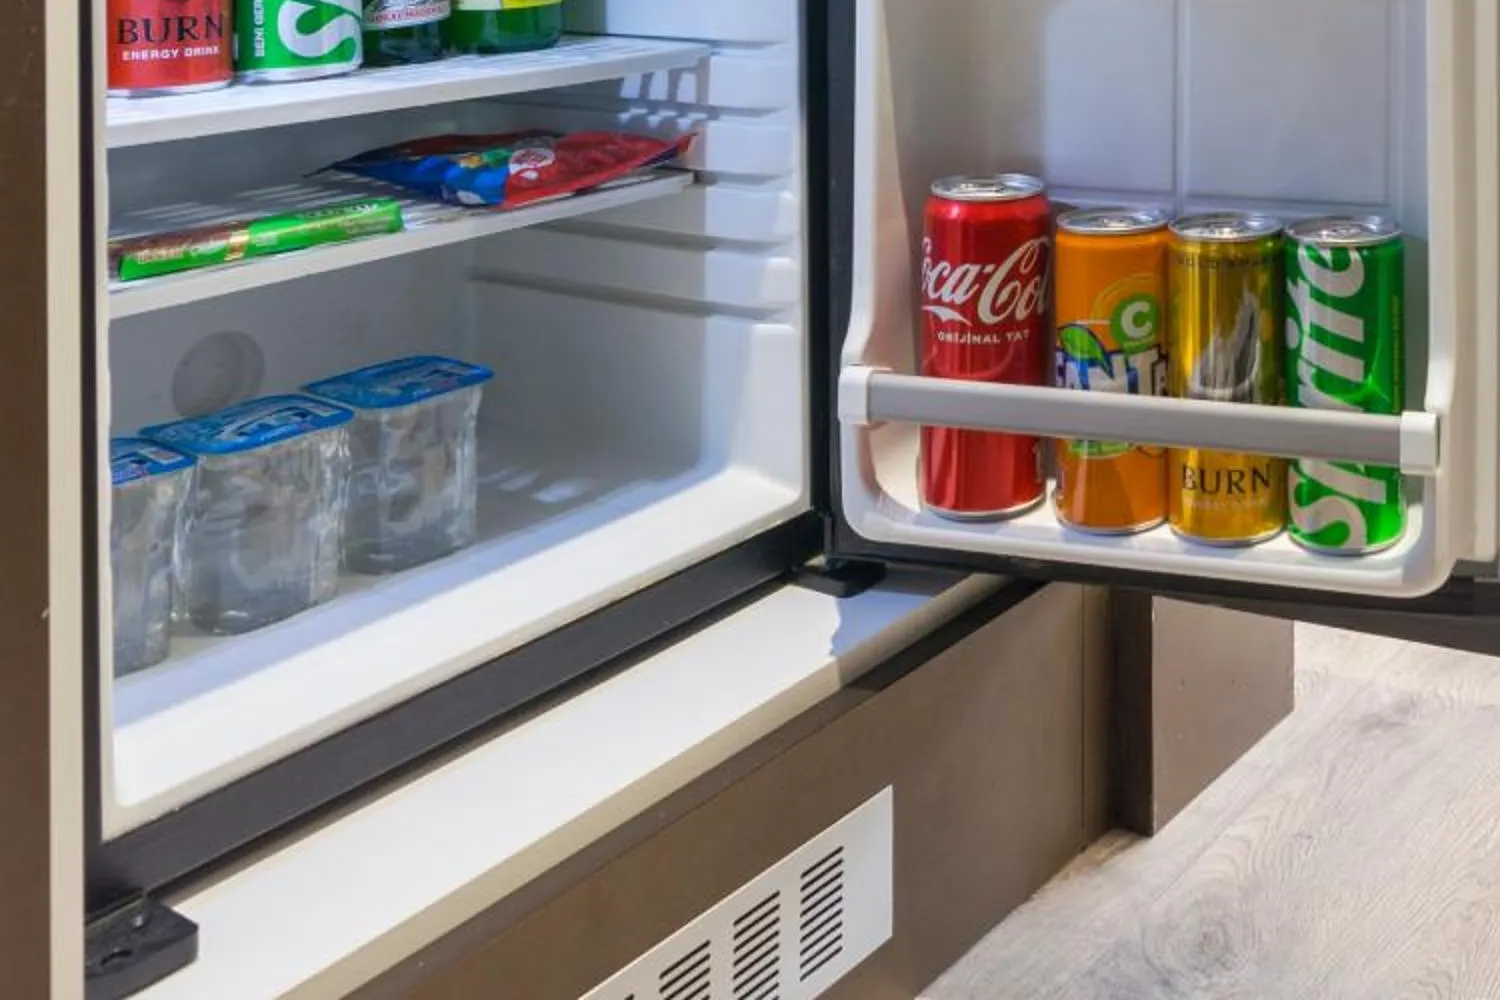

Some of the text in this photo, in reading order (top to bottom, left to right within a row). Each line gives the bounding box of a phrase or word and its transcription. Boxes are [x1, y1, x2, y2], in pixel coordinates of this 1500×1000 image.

[117, 13, 224, 45] BURN
[121, 48, 180, 61] ENERGY
[921, 235, 1049, 325] oca-Col
[1004, 327, 1031, 342] TAT
[1181, 463, 1271, 495] BURN
